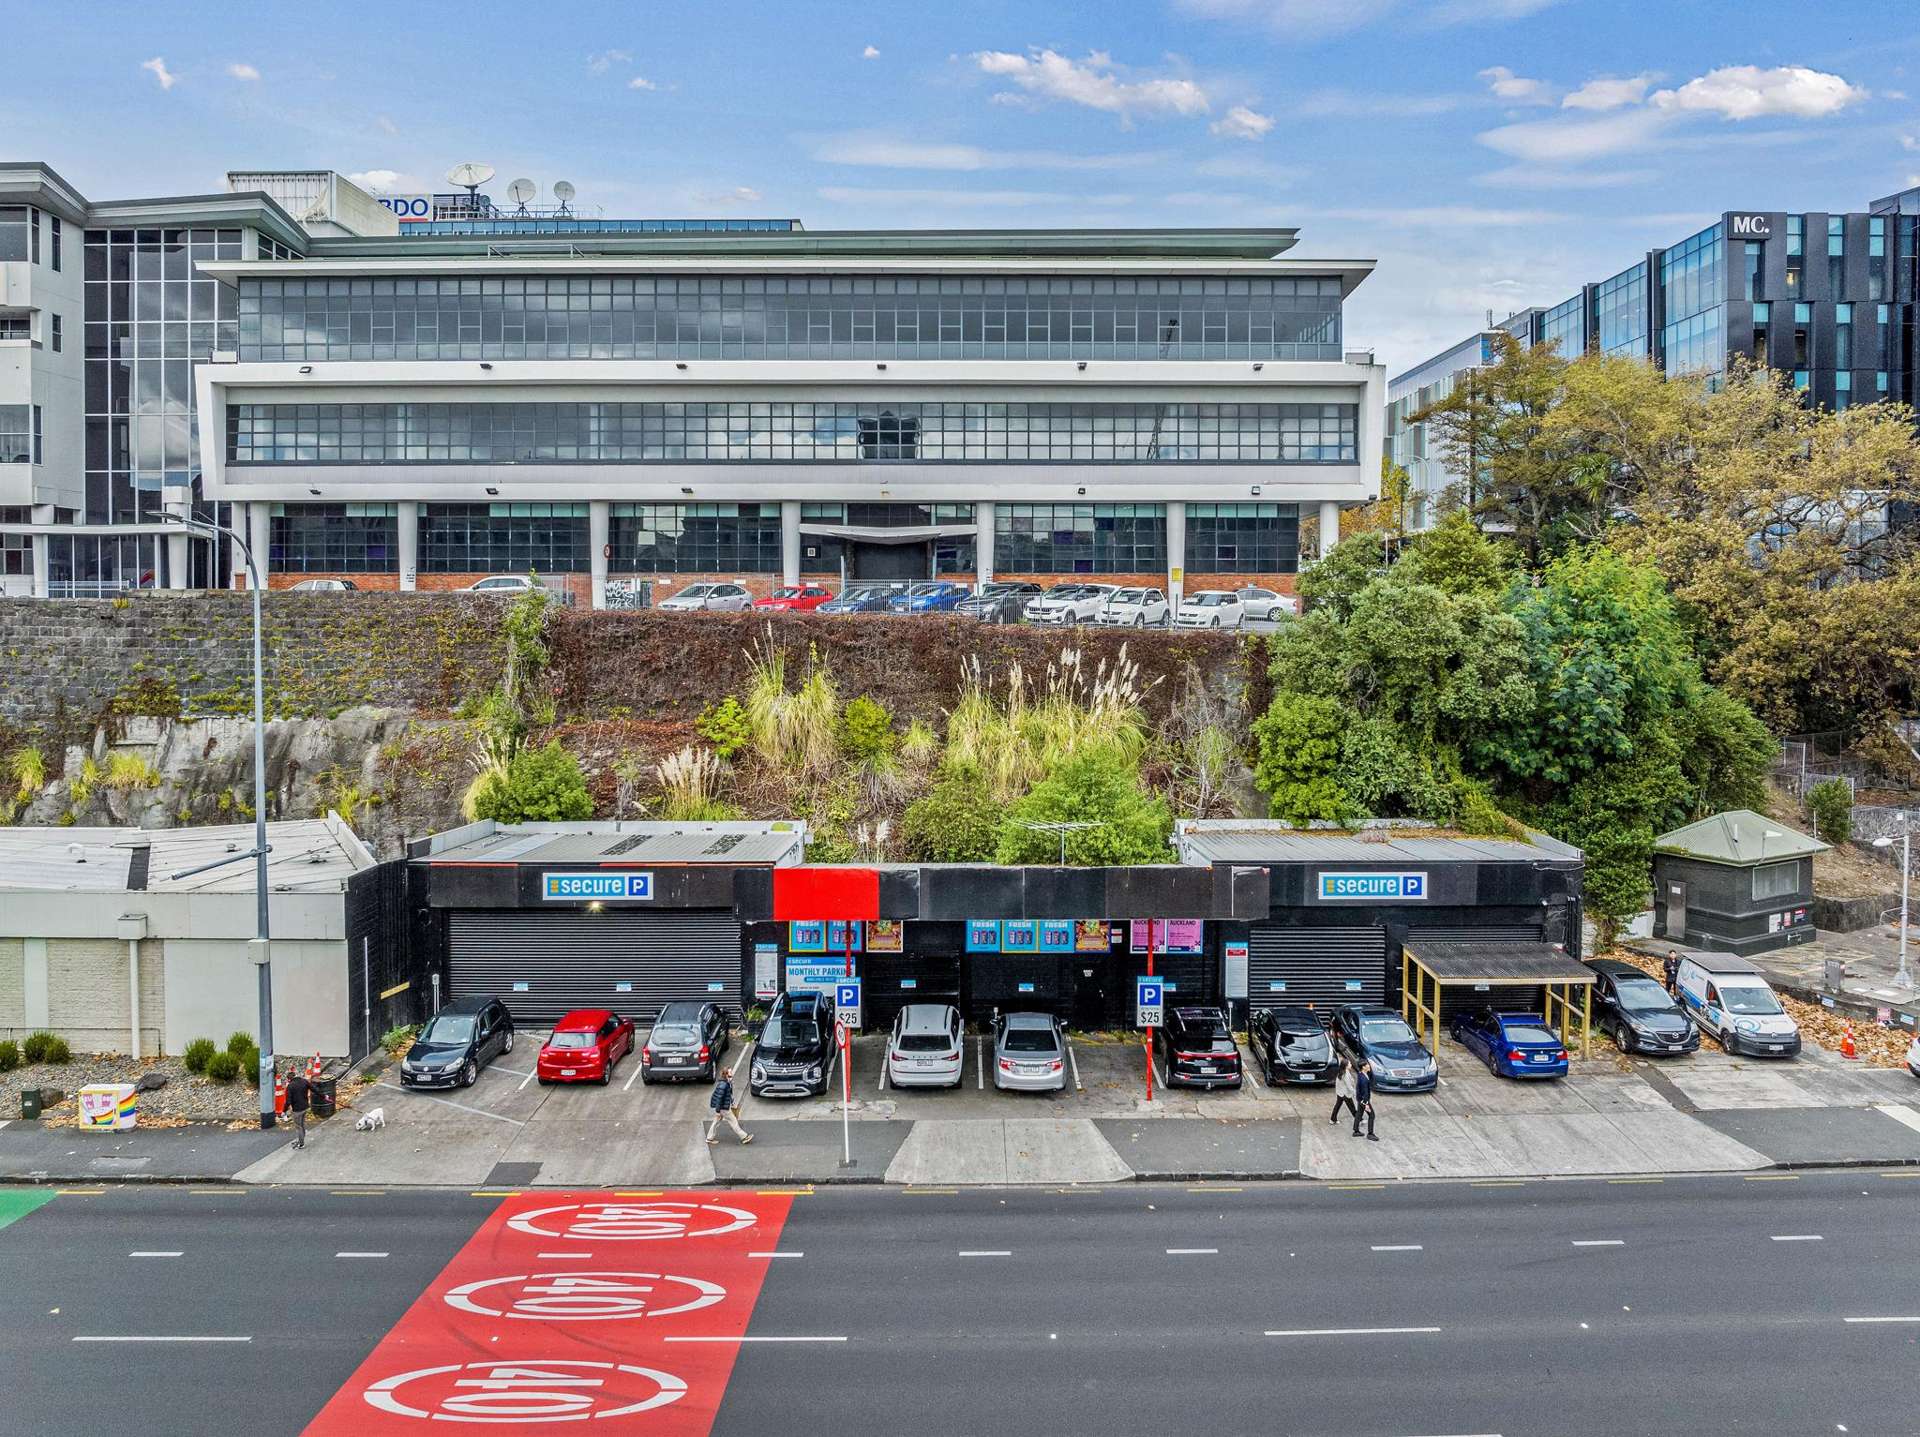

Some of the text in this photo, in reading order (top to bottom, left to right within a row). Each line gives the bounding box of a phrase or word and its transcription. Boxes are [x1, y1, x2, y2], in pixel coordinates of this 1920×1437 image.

[1733, 216, 1770, 233] MC.
[561, 879, 644, 894] secure P
[1337, 879, 1418, 894] secure P
[788, 967, 820, 976] MONTHLY
[842, 989, 854, 1004] P
[1144, 988, 1156, 1003] P
[839, 1012, 857, 1024] $25
[1141, 1011, 1160, 1024] $25
